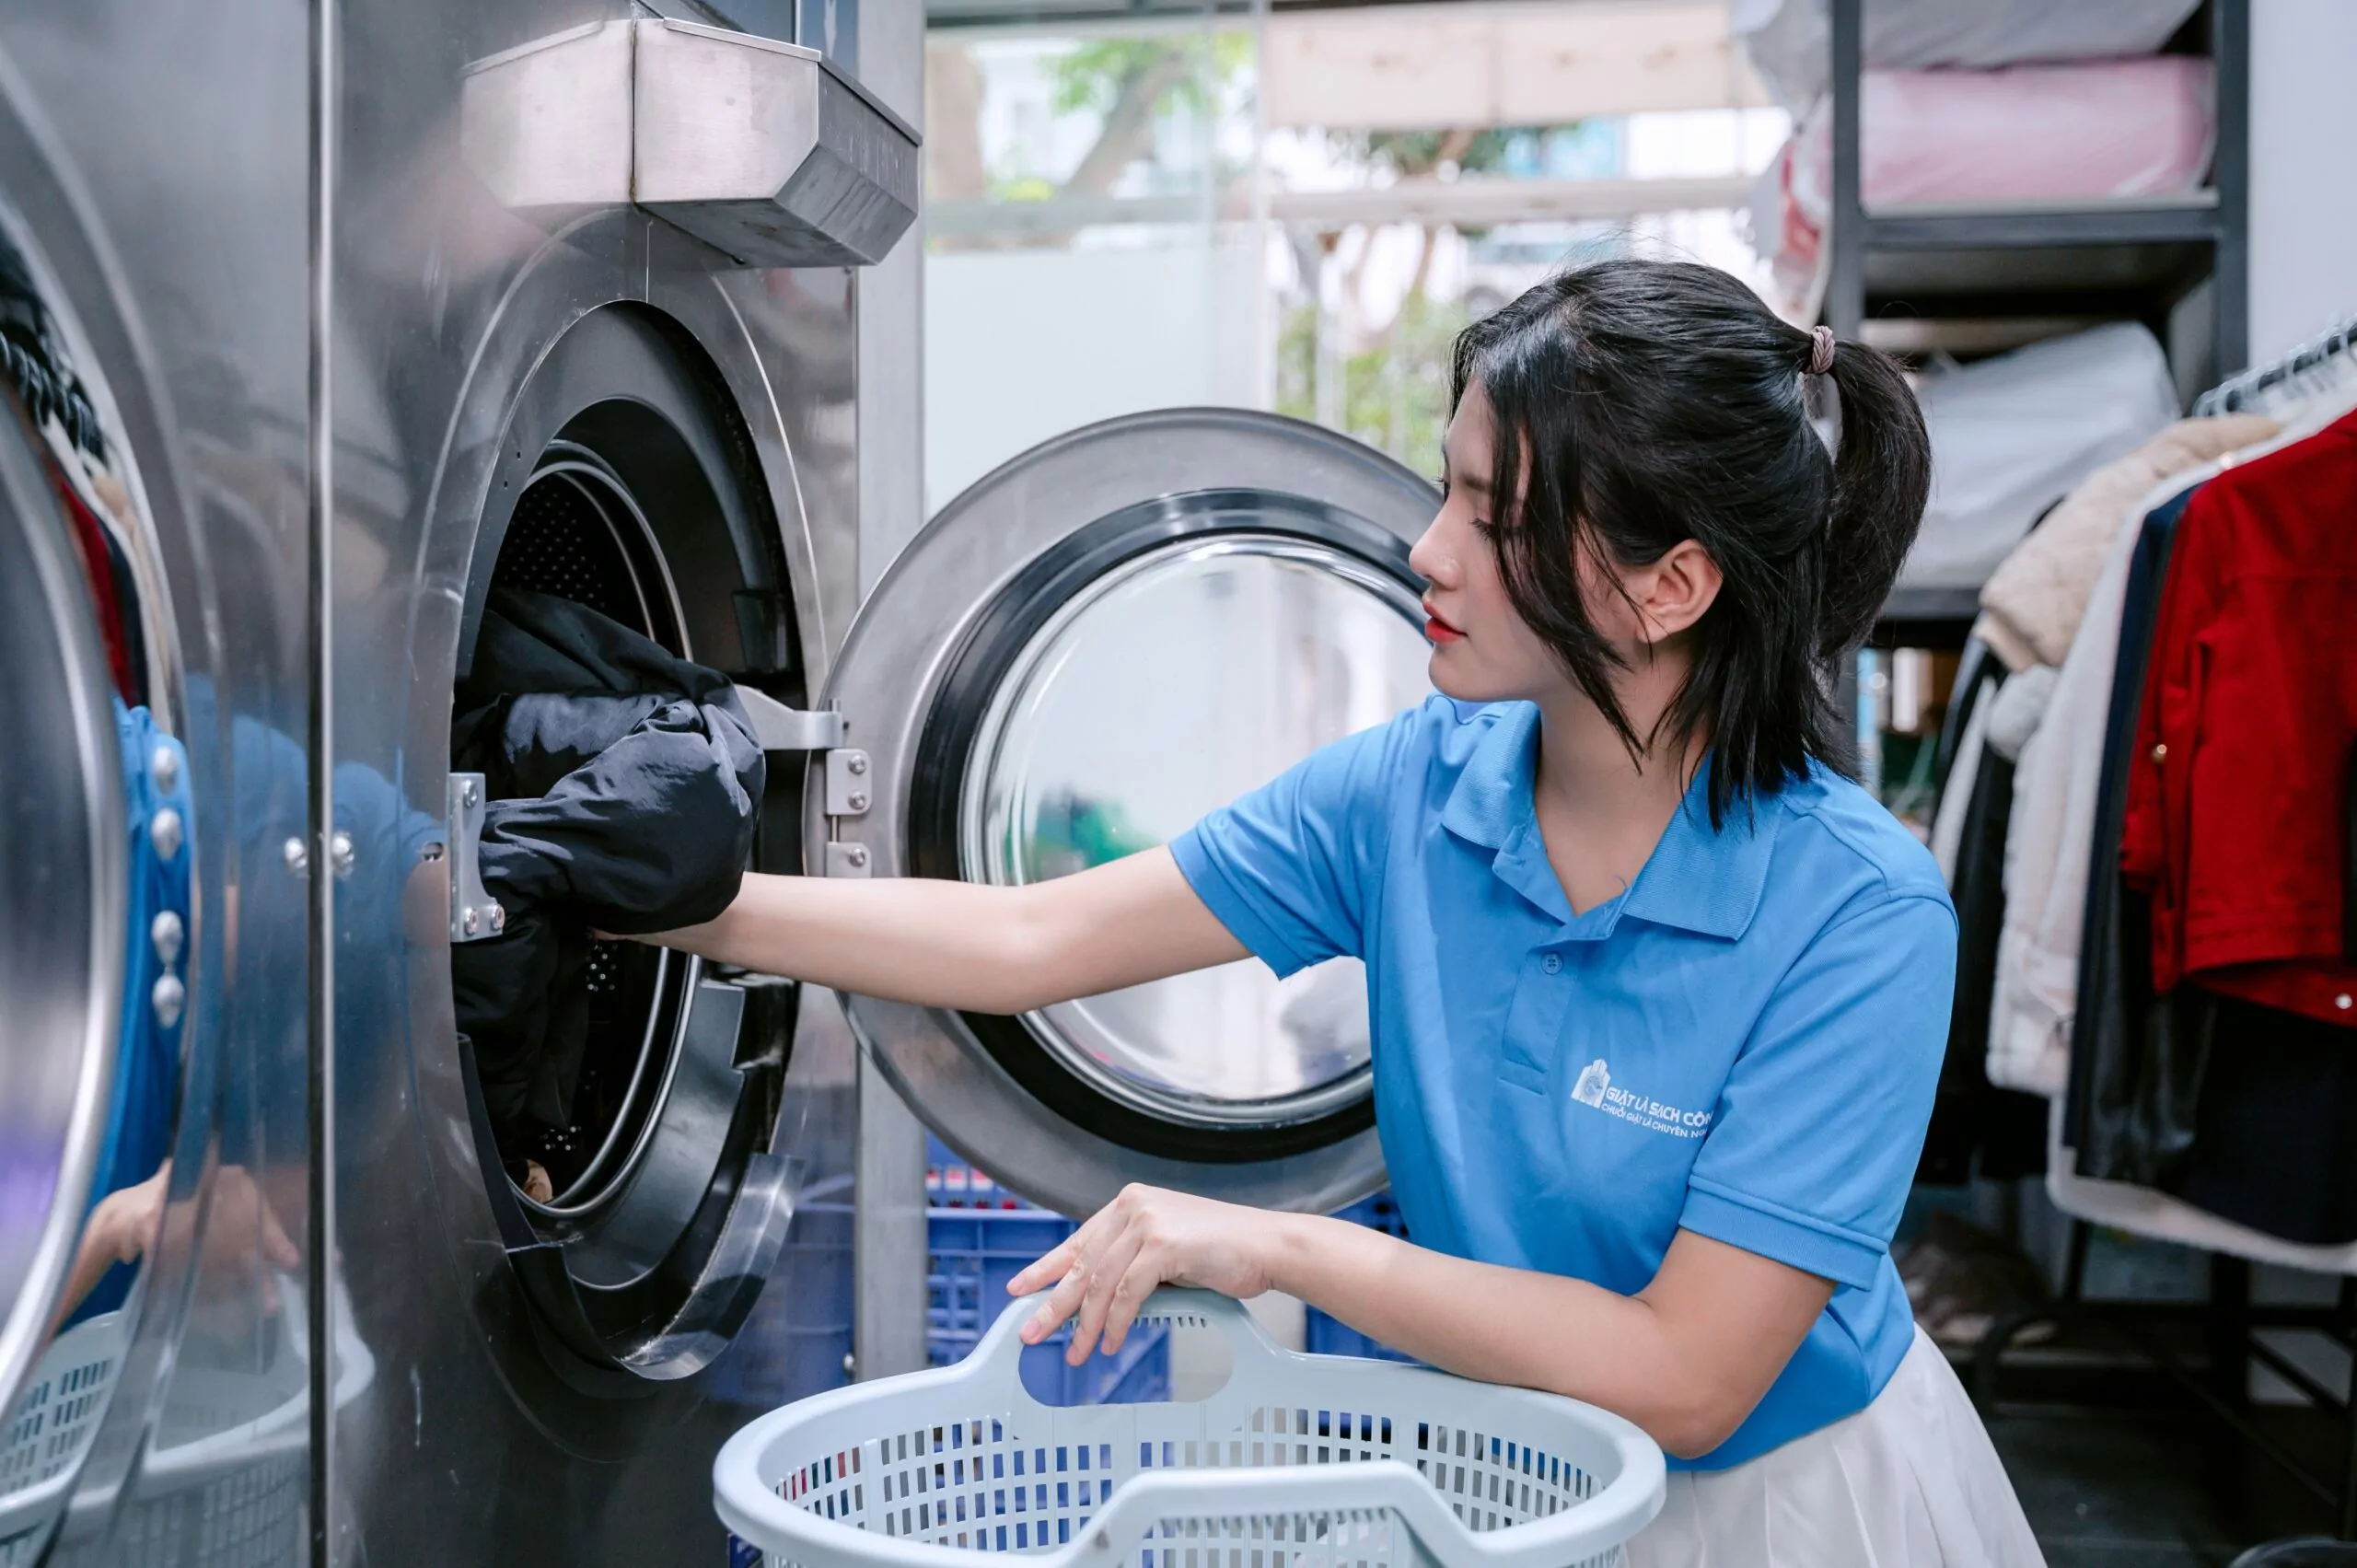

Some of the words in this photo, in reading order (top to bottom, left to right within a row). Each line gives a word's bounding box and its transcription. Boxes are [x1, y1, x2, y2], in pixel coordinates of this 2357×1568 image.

[1606, 1086, 1636, 1108] GIẶT
[1634, 1096, 1649, 1112] LÀ
[1648, 1101, 1680, 1123] SẠCH
[1652, 1121, 1688, 1138] CHUYÊN
